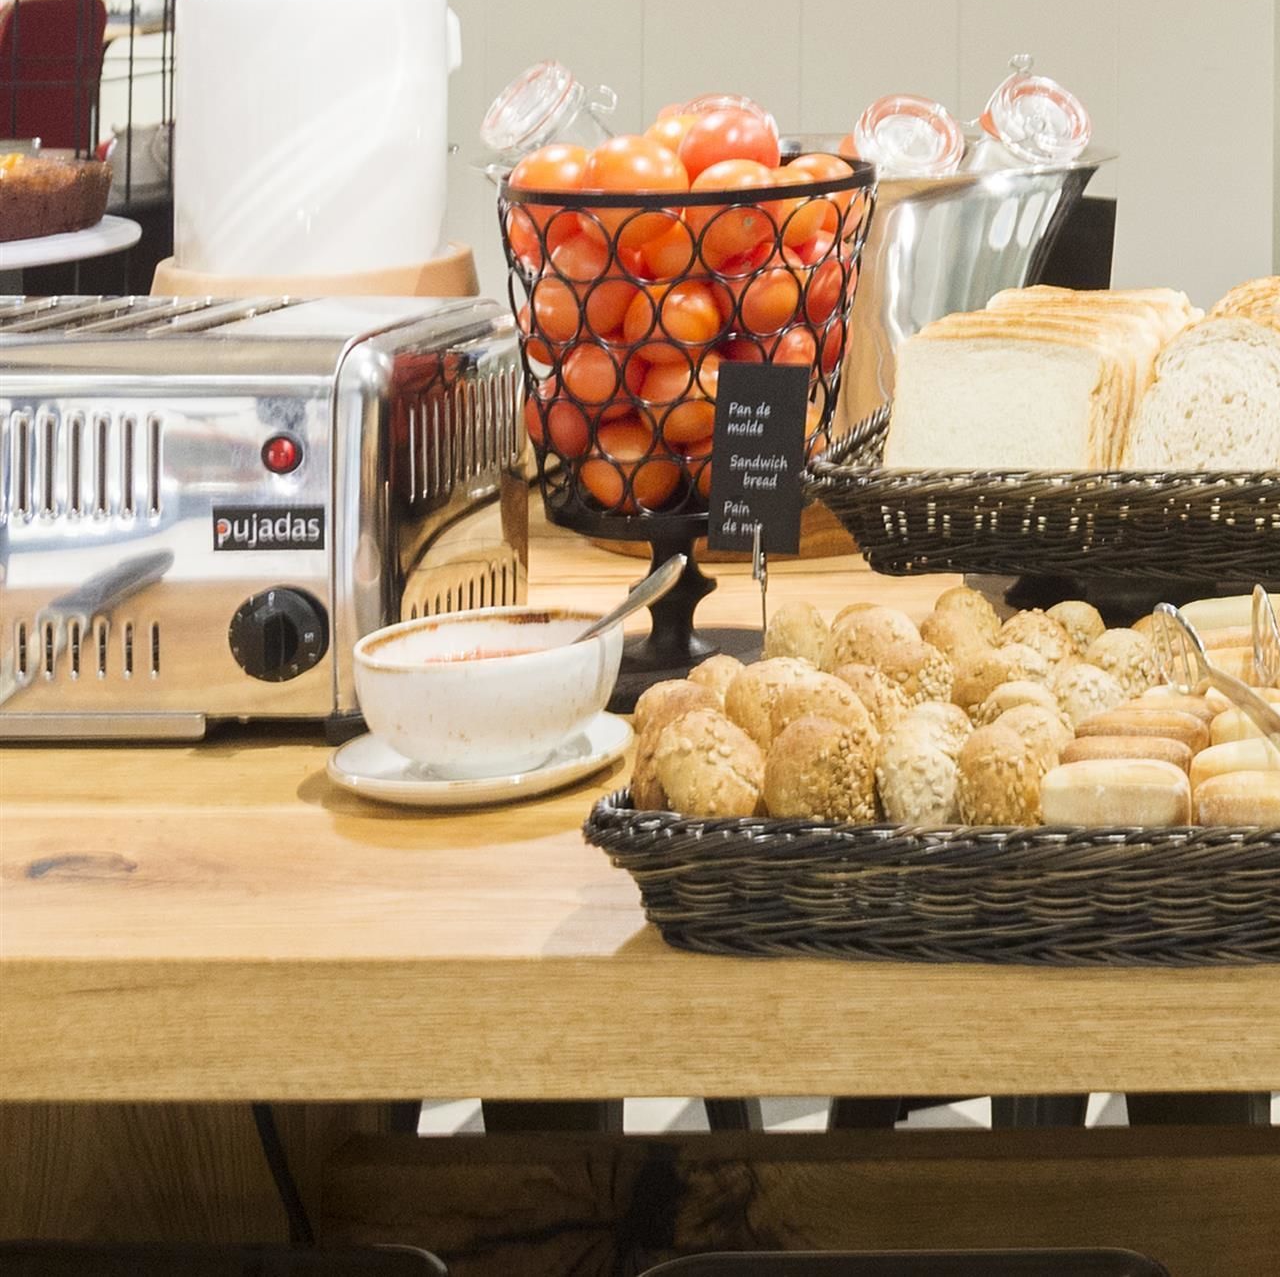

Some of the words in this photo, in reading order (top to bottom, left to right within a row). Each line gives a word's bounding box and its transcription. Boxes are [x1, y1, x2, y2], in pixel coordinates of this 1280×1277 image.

[728, 401, 752, 417] Pan
[756, 401, 771, 417] de
[727, 420, 764, 435] molde
[730, 454, 788, 470] Sandwich
[743, 473, 777, 489] bread
[723, 500, 750, 515] Pain
[216, 511, 320, 548] pujadas
[722, 519, 737, 534] de
